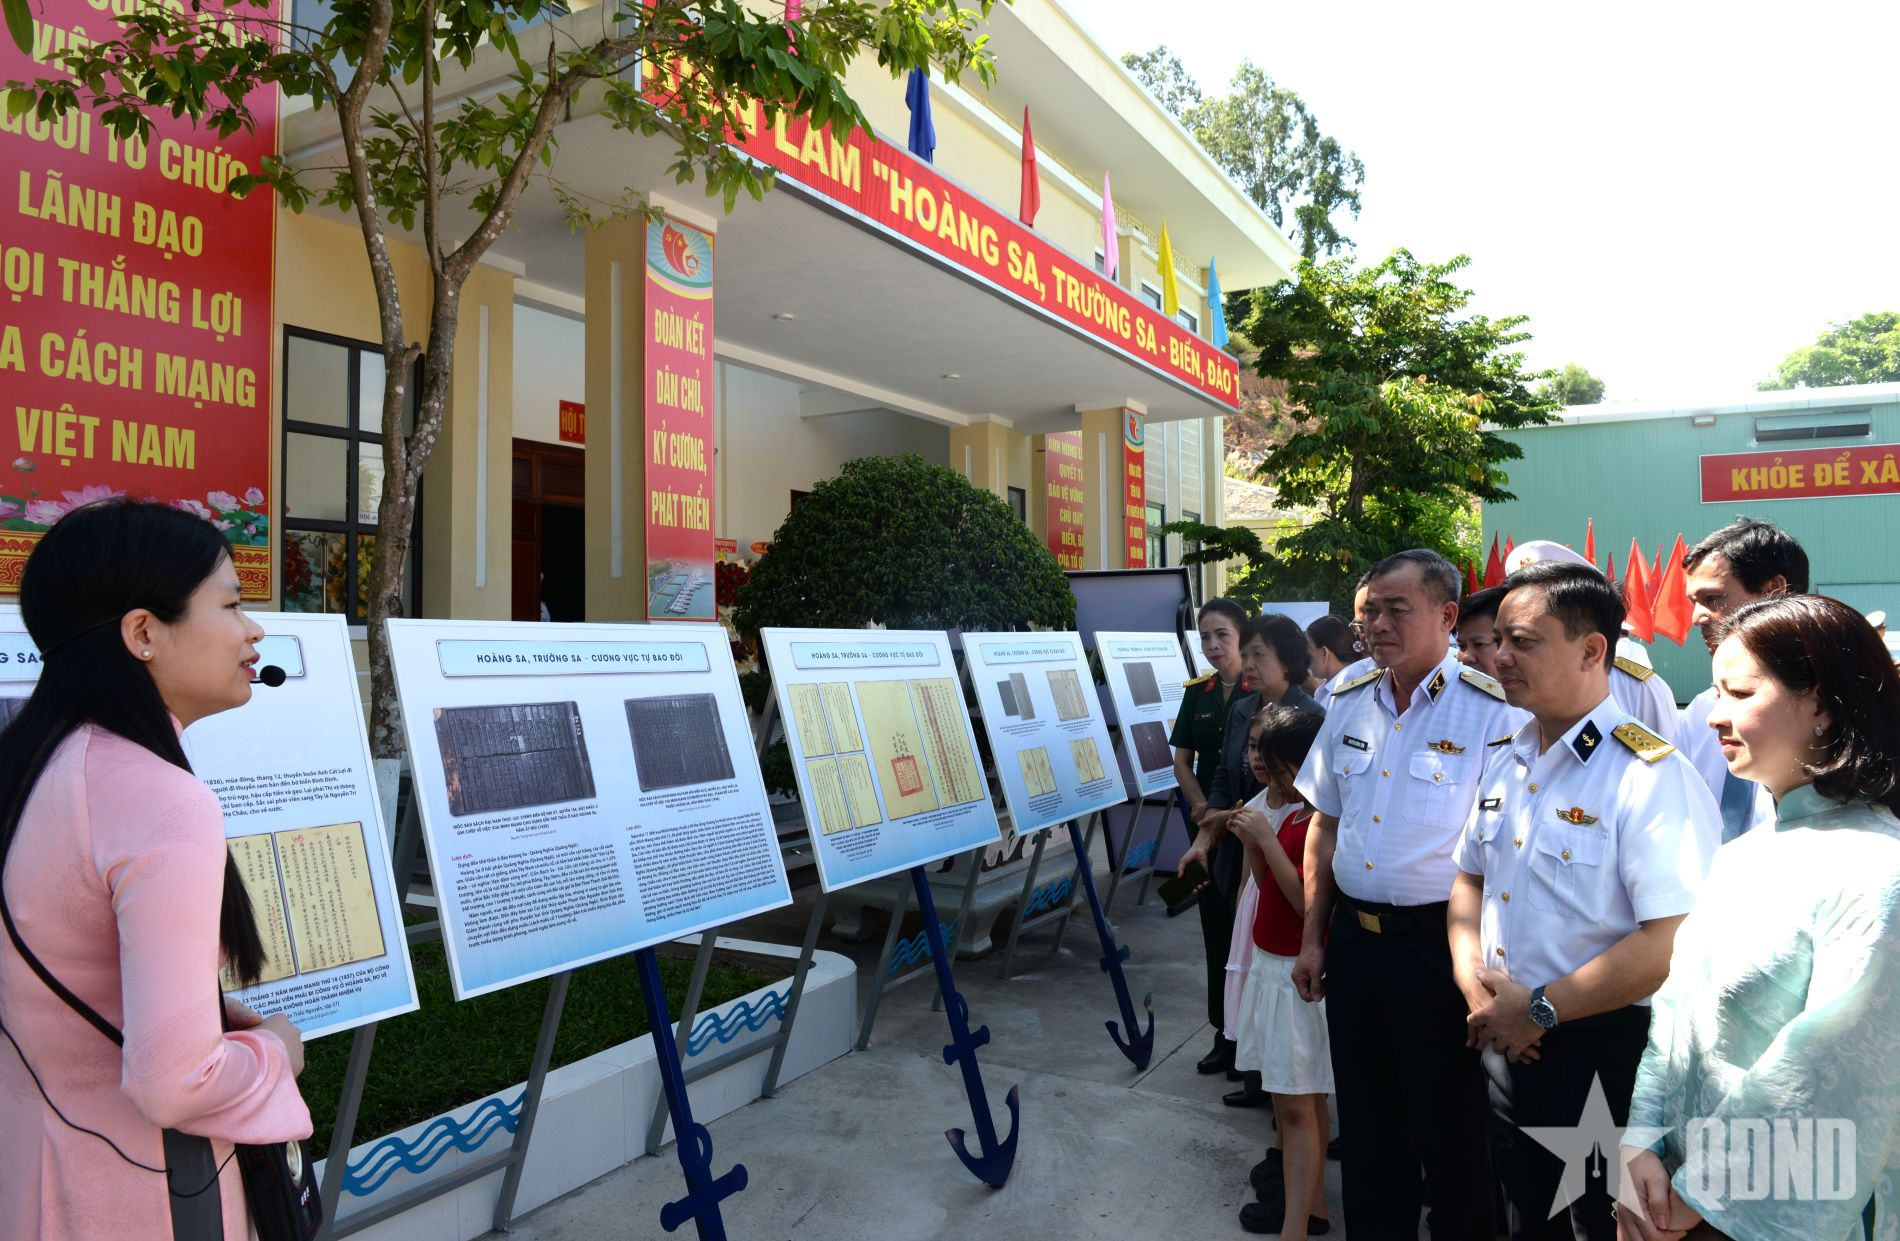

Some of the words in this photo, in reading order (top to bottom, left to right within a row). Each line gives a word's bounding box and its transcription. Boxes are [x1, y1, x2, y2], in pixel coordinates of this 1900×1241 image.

[19, 169, 121, 238] LÃNH
[132, 201, 203, 260] ĐẠO
[0, 245, 44, 302] ỌI
[58, 255, 180, 324] THẮNG
[192, 288, 242, 342] LỢI
[873, 159, 999, 267] "HOÀNG
[1008, 240, 1046, 302] SA,
[1052, 265, 1131, 339] TRƯỜNG
[1136, 317, 1158, 355] SA
[1170, 338, 1204, 386] BIỂN,
[1207, 356, 1231, 394] ĐẢO
[654, 306, 683, 350] ĐOÀN
[686, 311, 705, 360] KẾT,
[40, 329, 143, 390] CÁCH
[156, 352, 256, 409] MẠNG
[656, 365, 678, 408] DÂN
[680, 369, 704, 418] CHỦ,
[15, 403, 100, 466] VIỆT
[112, 419, 196, 470] NAM
[561, 407, 577, 437] HỘI
[579, 411, 586, 435] T
[653, 420, 667, 465] KỶ
[670, 432, 707, 476] CƯƠNG,
[1048, 438, 1061, 455] ANH
[1059, 462, 1077, 482] QUYẾT
[1731, 457, 1805, 492] KHỎE
[1813, 451, 1851, 486] ĐỂ
[1048, 480, 1060, 499] BẢO
[651, 485, 678, 527] PHÁT
[681, 484, 710, 531] TRIỂN
[1059, 504, 1072, 523] CHỦ
[17, 652, 39, 664] SA
[475, 652, 513, 662] HOÀNG
[514, 654, 531, 664] SA,
[532, 652, 569, 662] TRƯỜNG
[590, 653, 621, 661] CƯƠNG
[622, 653, 639, 663] VỰC
[640, 653, 651, 663] TỰ
[651, 653, 668, 661] BAO
[668, 652, 683, 660] ĐỜI
[235, 783, 255, 791] thuyền
[329, 791, 350, 799] Nguyễn
[249, 992, 269, 1002] THÁNG
[274, 988, 288, 996] NĂM
[288, 984, 303, 992] MINH
[303, 980, 320, 990] MẠNG
[320, 977, 331, 985] THỨ
[374, 963, 390, 972] CÔNG
[252, 1001, 266, 1009] CÁC
[281, 994, 293, 1002] VIÊN
[314, 985, 331, 994] CÔNG
[344, 977, 363, 987] HOÀNG
[282, 1000, 303, 1010] KHÔNG
[303, 996, 320, 1005] HOÀN
